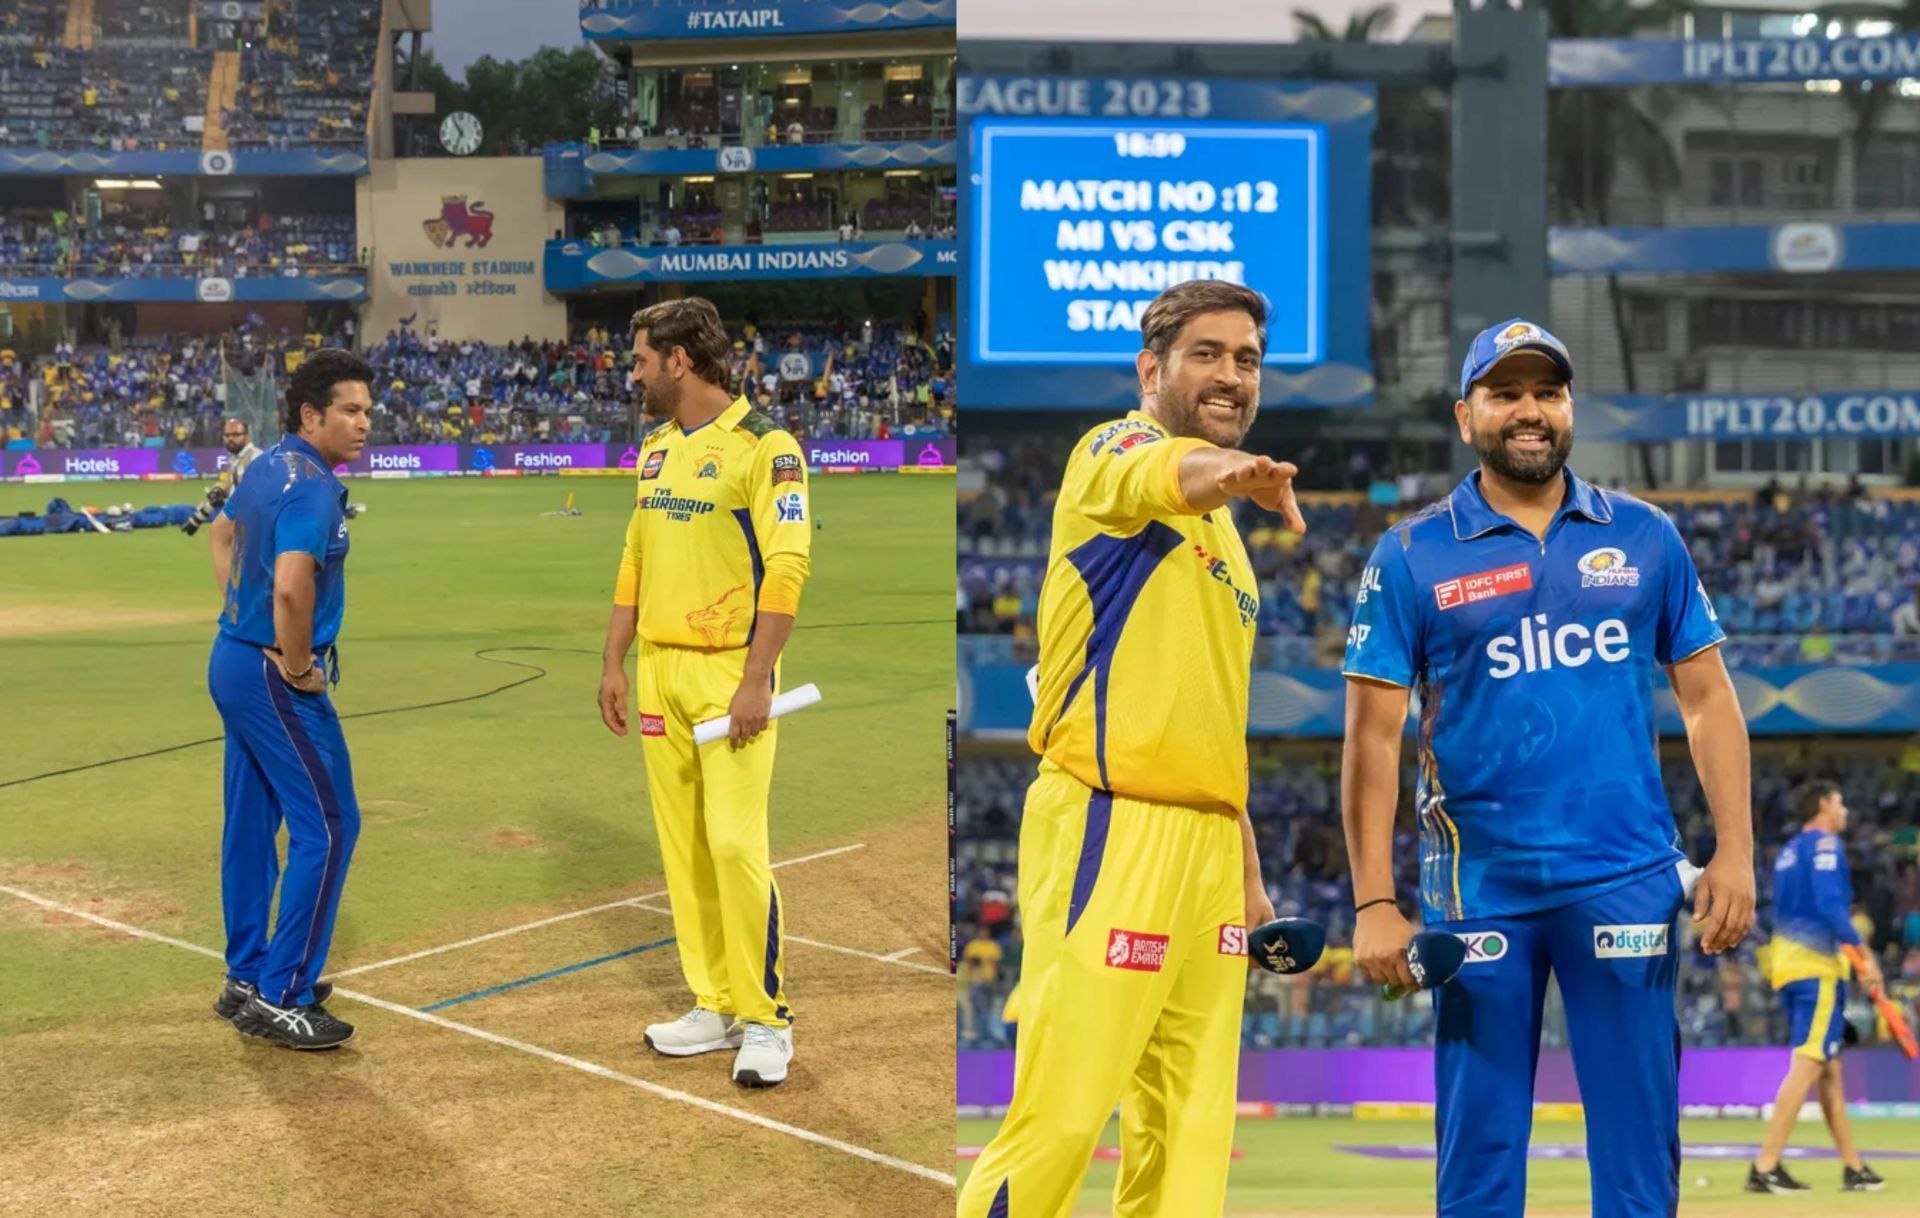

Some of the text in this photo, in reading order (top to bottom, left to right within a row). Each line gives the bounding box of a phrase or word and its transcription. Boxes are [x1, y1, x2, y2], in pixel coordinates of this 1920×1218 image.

[687, 9, 784, 29] #TATAIPL
[1102, 80, 1212, 117] 2023
[1021, 180, 1152, 212] MATCH
[1159, 181, 1216, 212] NO
[1056, 219, 1235, 252] MI VS CSK
[390, 261, 535, 276] WANKHEDE STADIUM
[661, 250, 848, 272] MUMBAI INDIANS
[370, 453, 421, 468] Hotels
[515, 452, 572, 466] Fashion
[811, 449, 870, 463] Fashion
[65, 457, 120, 472] Hotels
[654, 488, 673, 496] TVS
[643, 496, 715, 514] EUROGRIP
[786, 508, 804, 520] IPL
[1465, 566, 1530, 591] IDFC FIRST
[1581, 574, 1640, 588] INDIANS
[1468, 587, 1498, 602] Bank
[1486, 613, 1630, 679] slice
[1133, 938, 1168, 954] BRITISH
[1615, 930, 1668, 954] digital
[1131, 952, 1165, 966] EMPIRE
